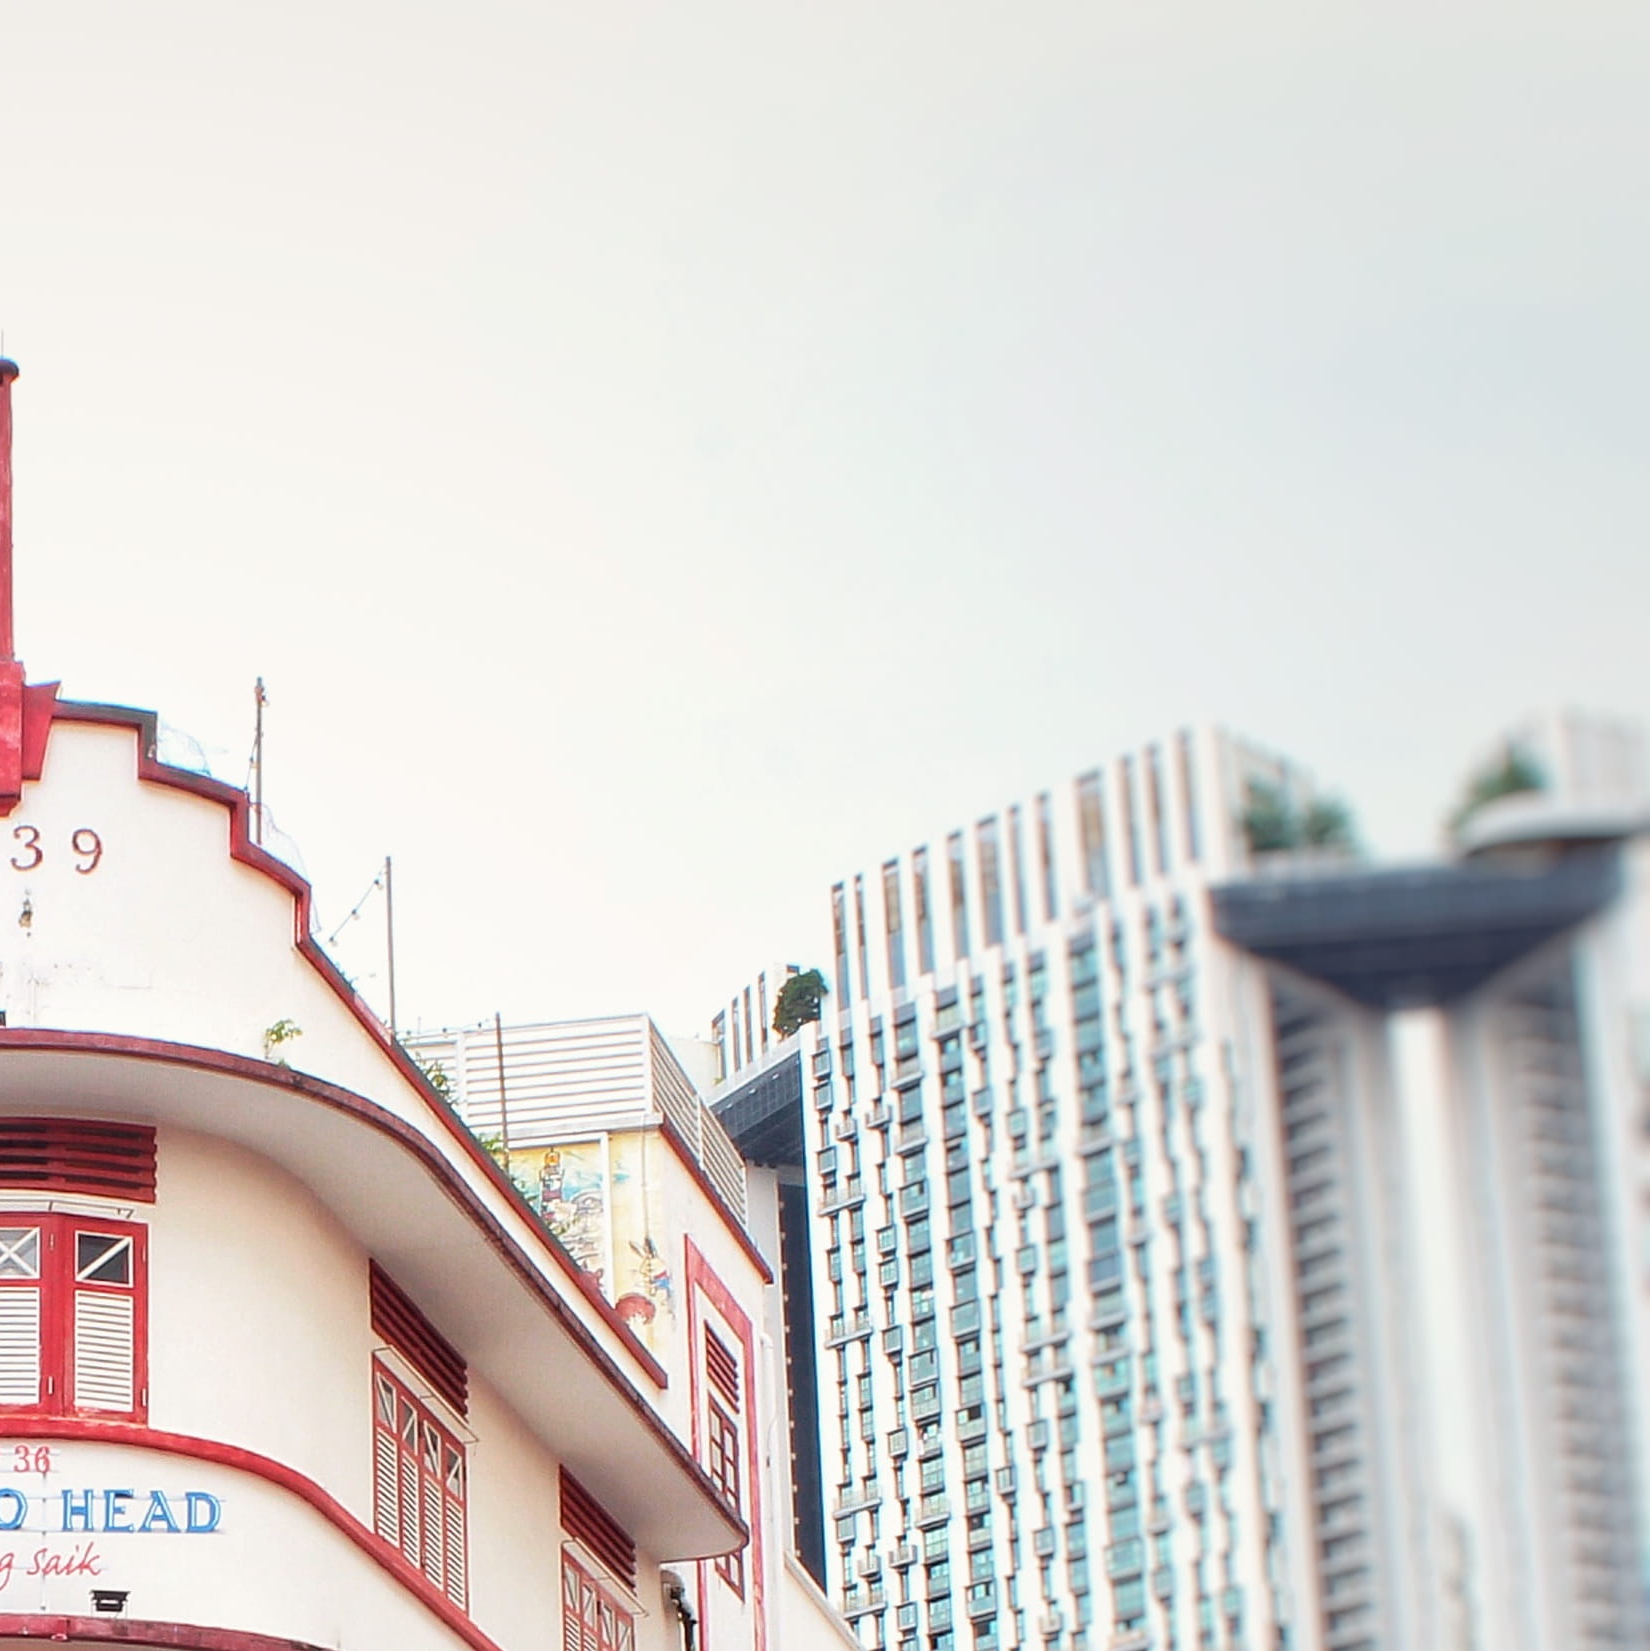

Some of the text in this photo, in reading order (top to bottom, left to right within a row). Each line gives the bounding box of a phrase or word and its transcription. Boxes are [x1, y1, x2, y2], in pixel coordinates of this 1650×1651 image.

[13, 1444, 52, 1475] 36
[61, 1488, 222, 1534] HEAD
[27, 1541, 102, 1577] Saik
